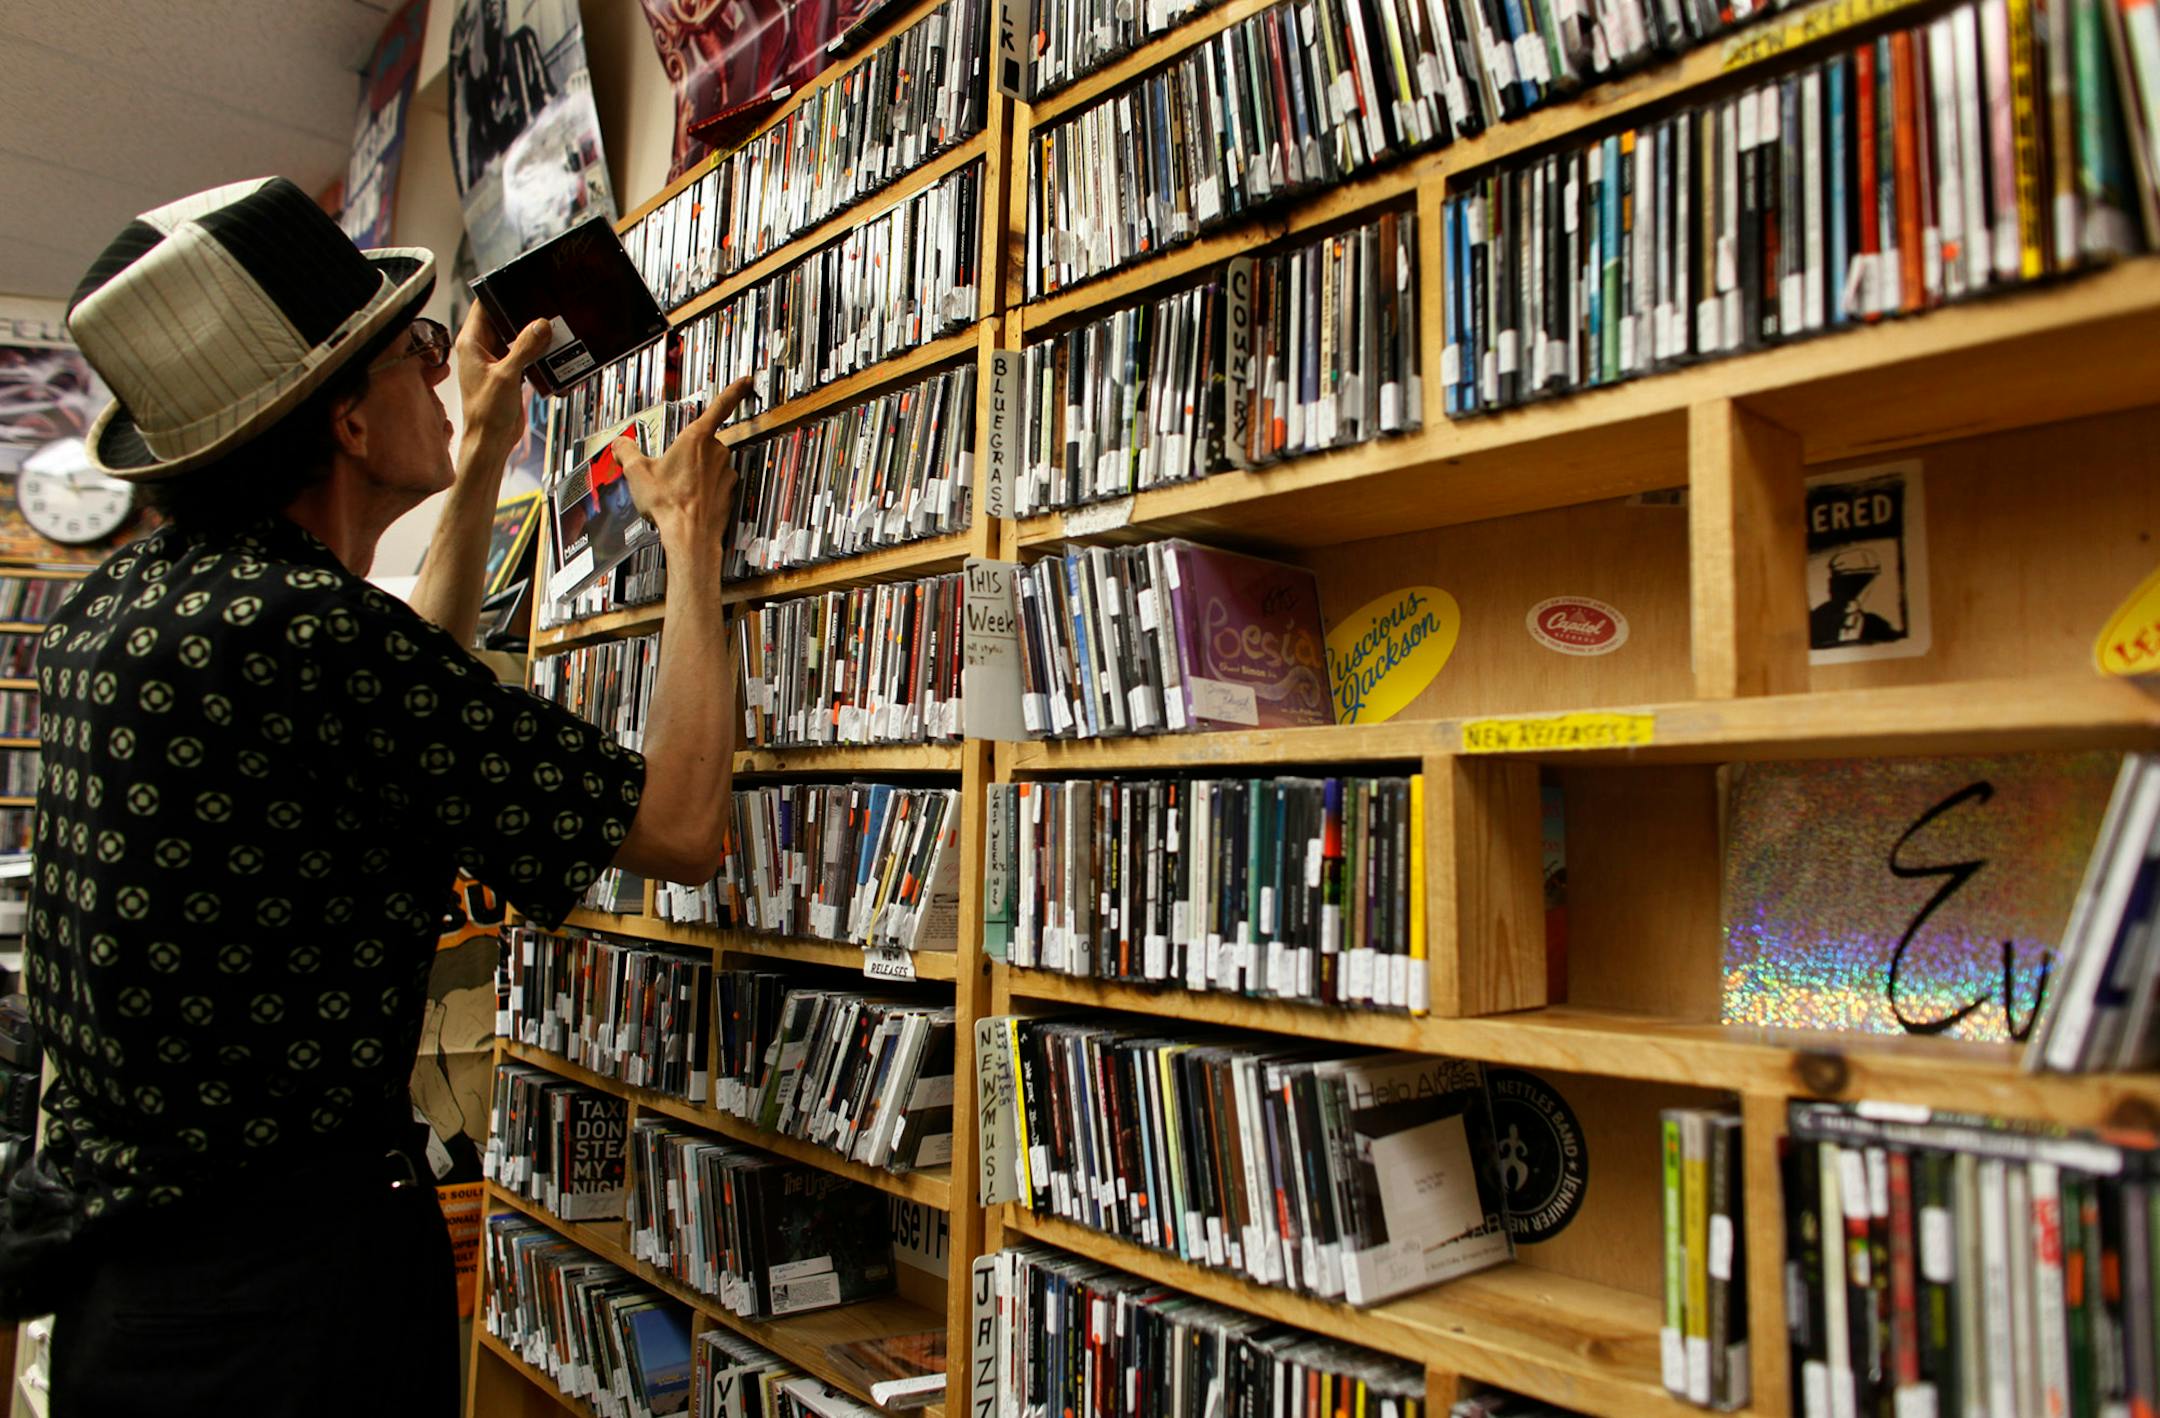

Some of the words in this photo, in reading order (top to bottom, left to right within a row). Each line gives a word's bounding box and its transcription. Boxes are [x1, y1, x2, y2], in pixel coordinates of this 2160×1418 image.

[1231, 270, 1248, 448] COUNTRY
[989, 358, 1008, 519] BLUEGRASS
[966, 563, 1002, 594] THIS
[967, 603, 1015, 633] Week
[1546, 612, 1606, 635] Capitol
[1467, 728, 1511, 748] NEW
[871, 963, 908, 977] RELEASES
[1497, 1079, 1556, 1114] NETTLES
[1551, 1109, 1580, 1159] BAND
[573, 1161, 607, 1179] MY
[1531, 1174, 1583, 1232] JENNIFER
[975, 1267, 995, 1418] JAZZ
